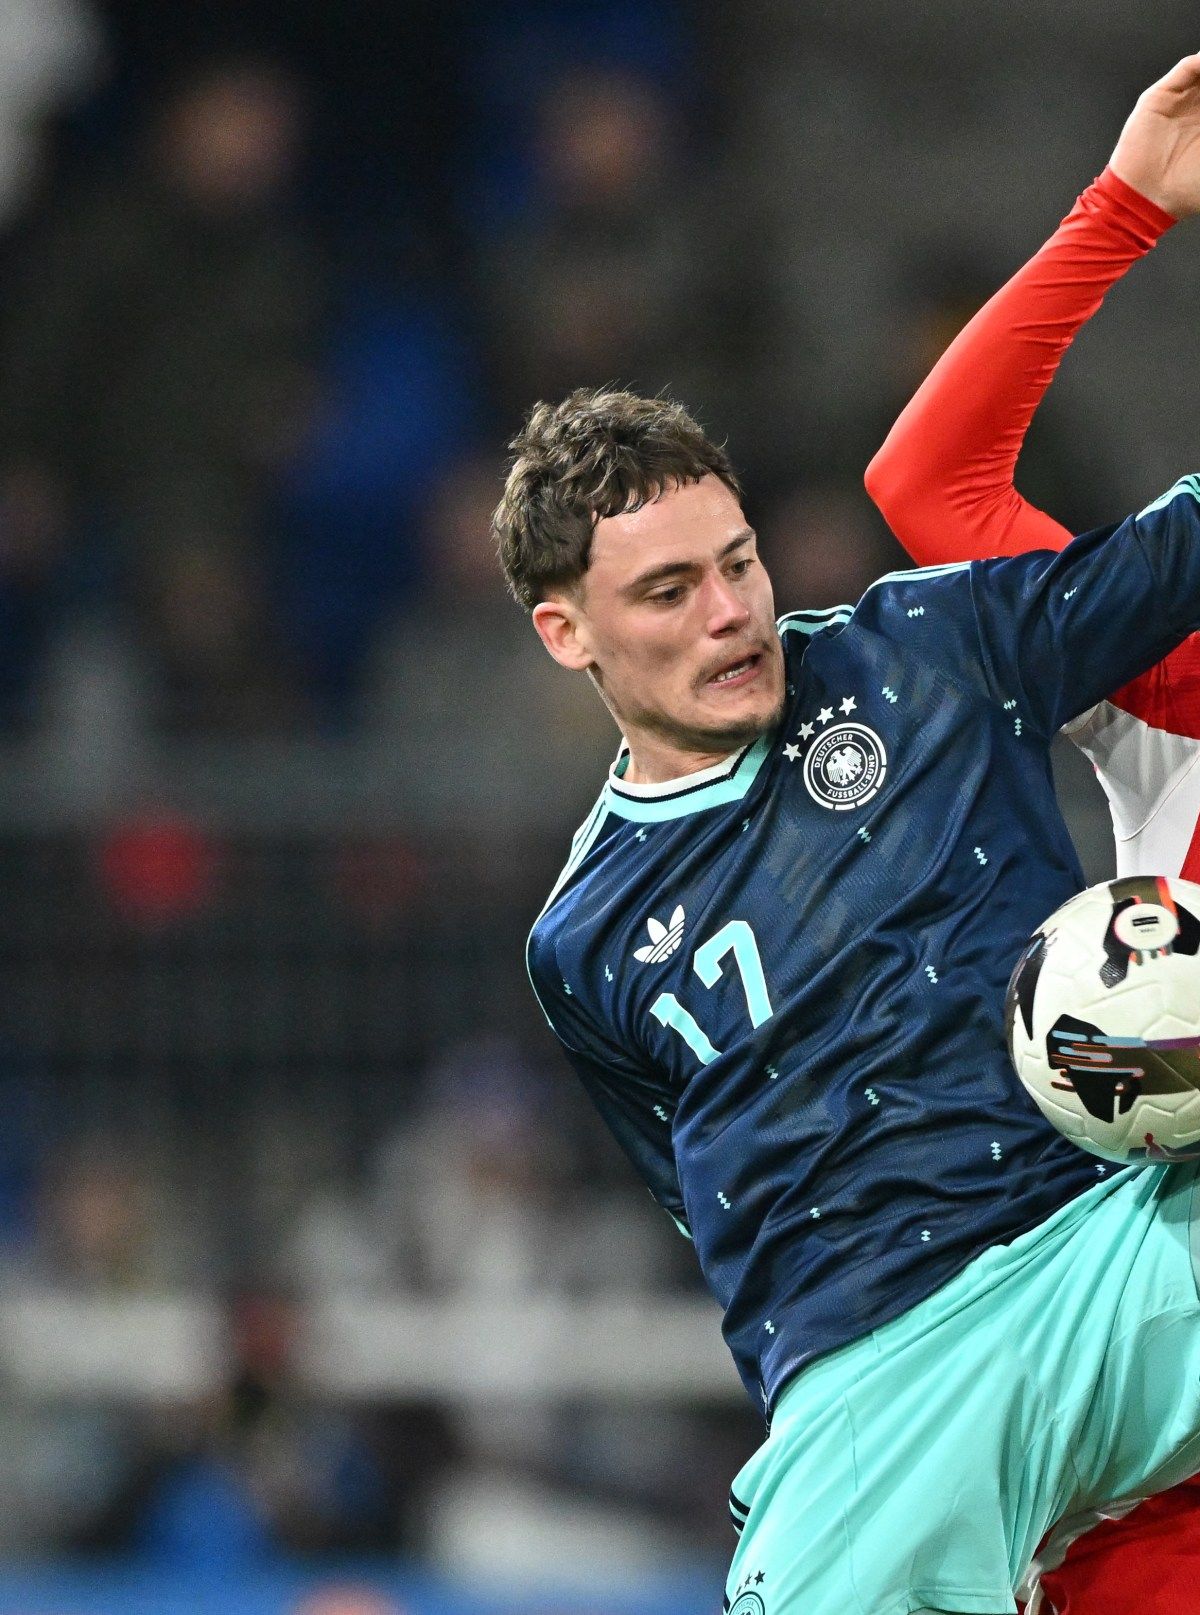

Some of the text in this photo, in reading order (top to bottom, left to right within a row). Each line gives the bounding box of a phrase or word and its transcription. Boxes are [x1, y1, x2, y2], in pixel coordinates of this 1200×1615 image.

[814, 733, 854, 768] DEUTSCHER
[826, 754, 876, 799] FUSSBALL-BUND
[650, 920, 773, 1065] 17
